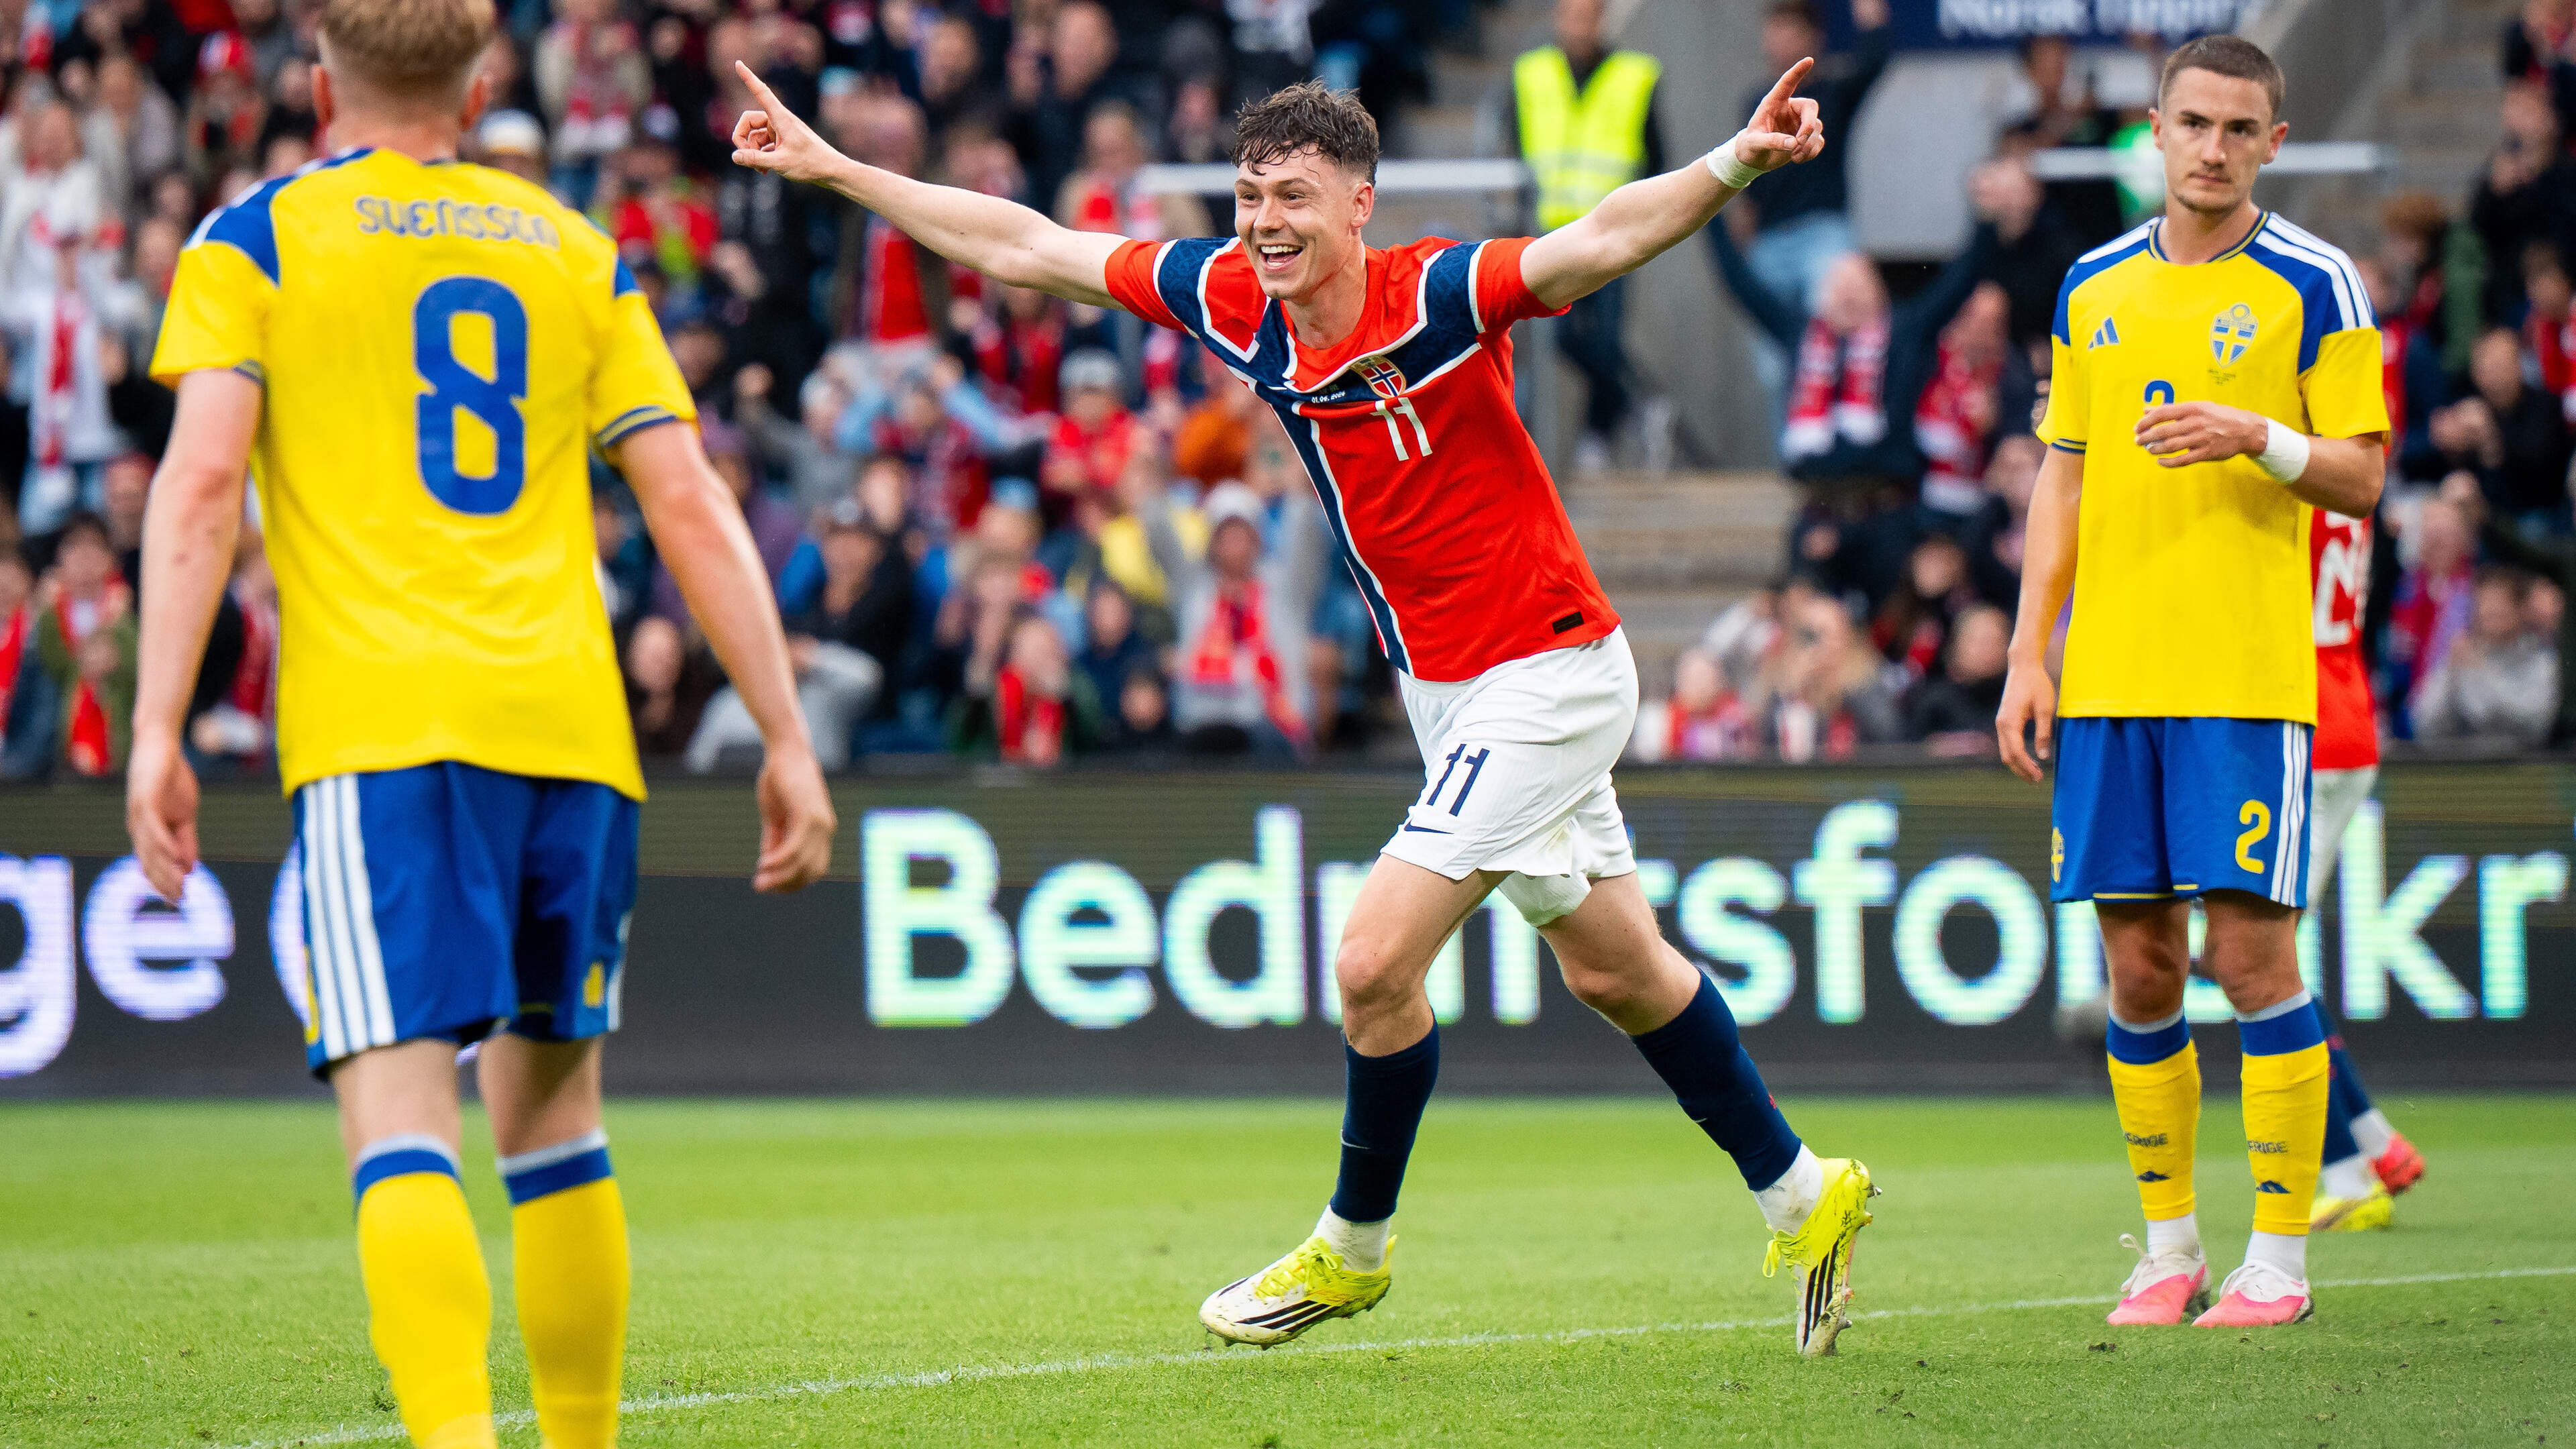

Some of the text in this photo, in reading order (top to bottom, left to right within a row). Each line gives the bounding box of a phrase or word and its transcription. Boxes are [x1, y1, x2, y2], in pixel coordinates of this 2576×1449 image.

[411, 276, 528, 515] 8
[1369, 396, 1433, 461] 11
[1426, 743, 1490, 817] 11
[2235, 798, 2271, 874] 2
[860, 798, 2571, 1029] Bedrsfokr
